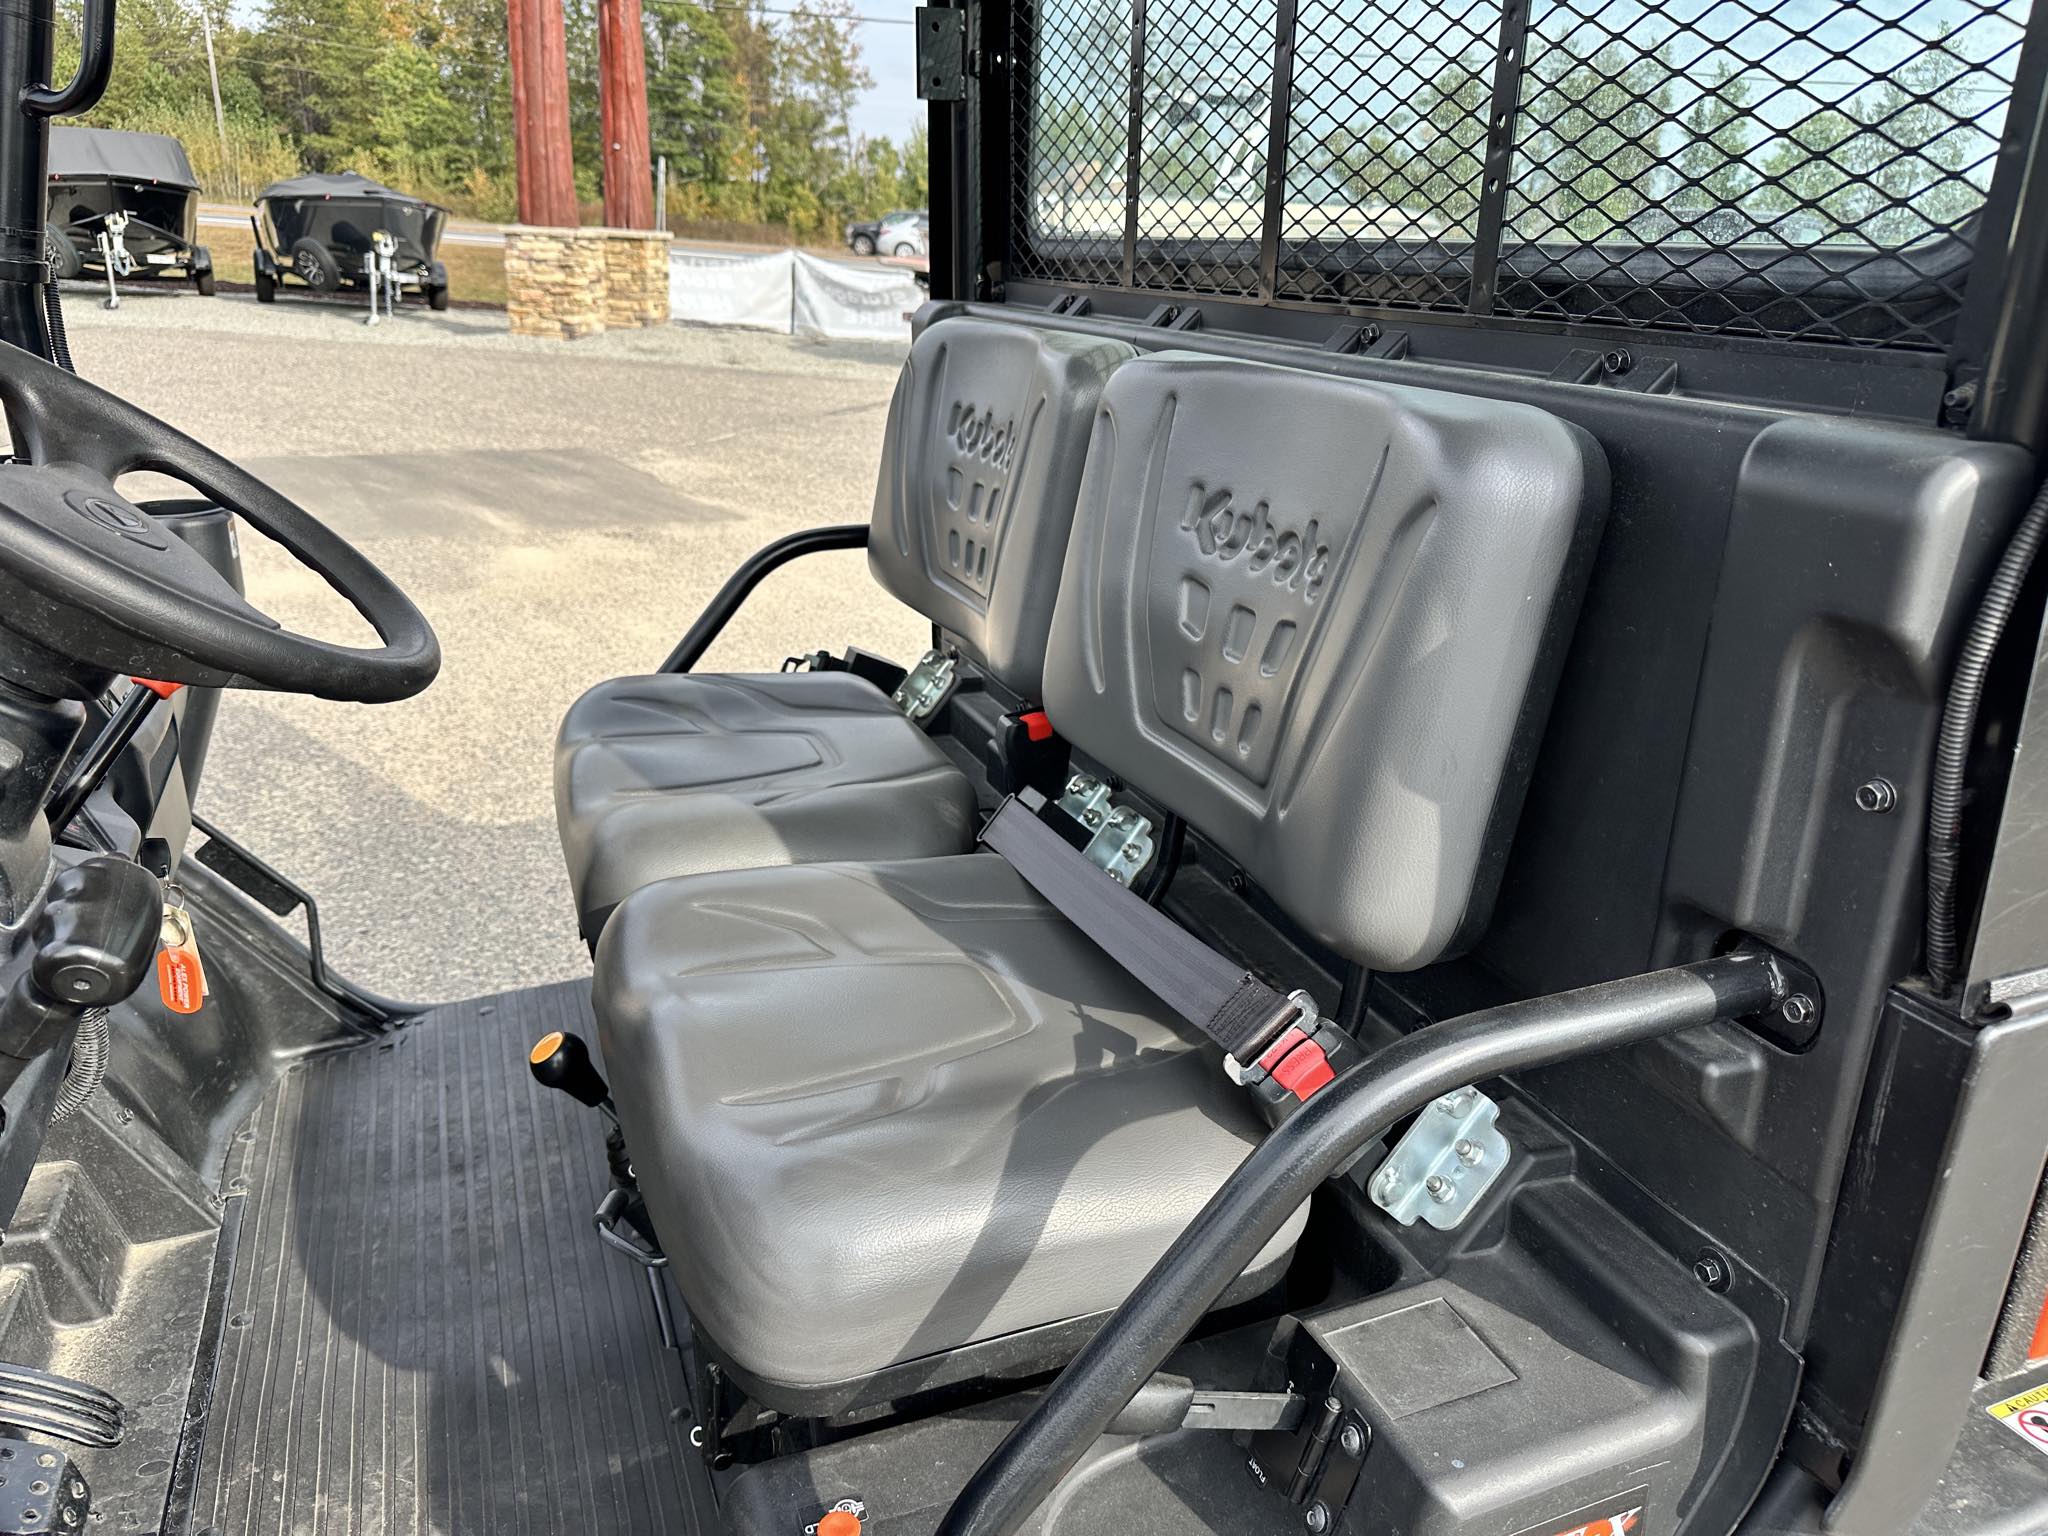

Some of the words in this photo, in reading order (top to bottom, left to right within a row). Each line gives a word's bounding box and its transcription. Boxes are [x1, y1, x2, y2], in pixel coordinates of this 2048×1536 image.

[947, 400, 1016, 475] Kubota
[1180, 479, 1329, 604] Kubota
[1281, 1046, 1312, 1074] PRESS
[2015, 1386, 2048, 1408] CAUTI
[1248, 1458, 1267, 1484] FLOAT
